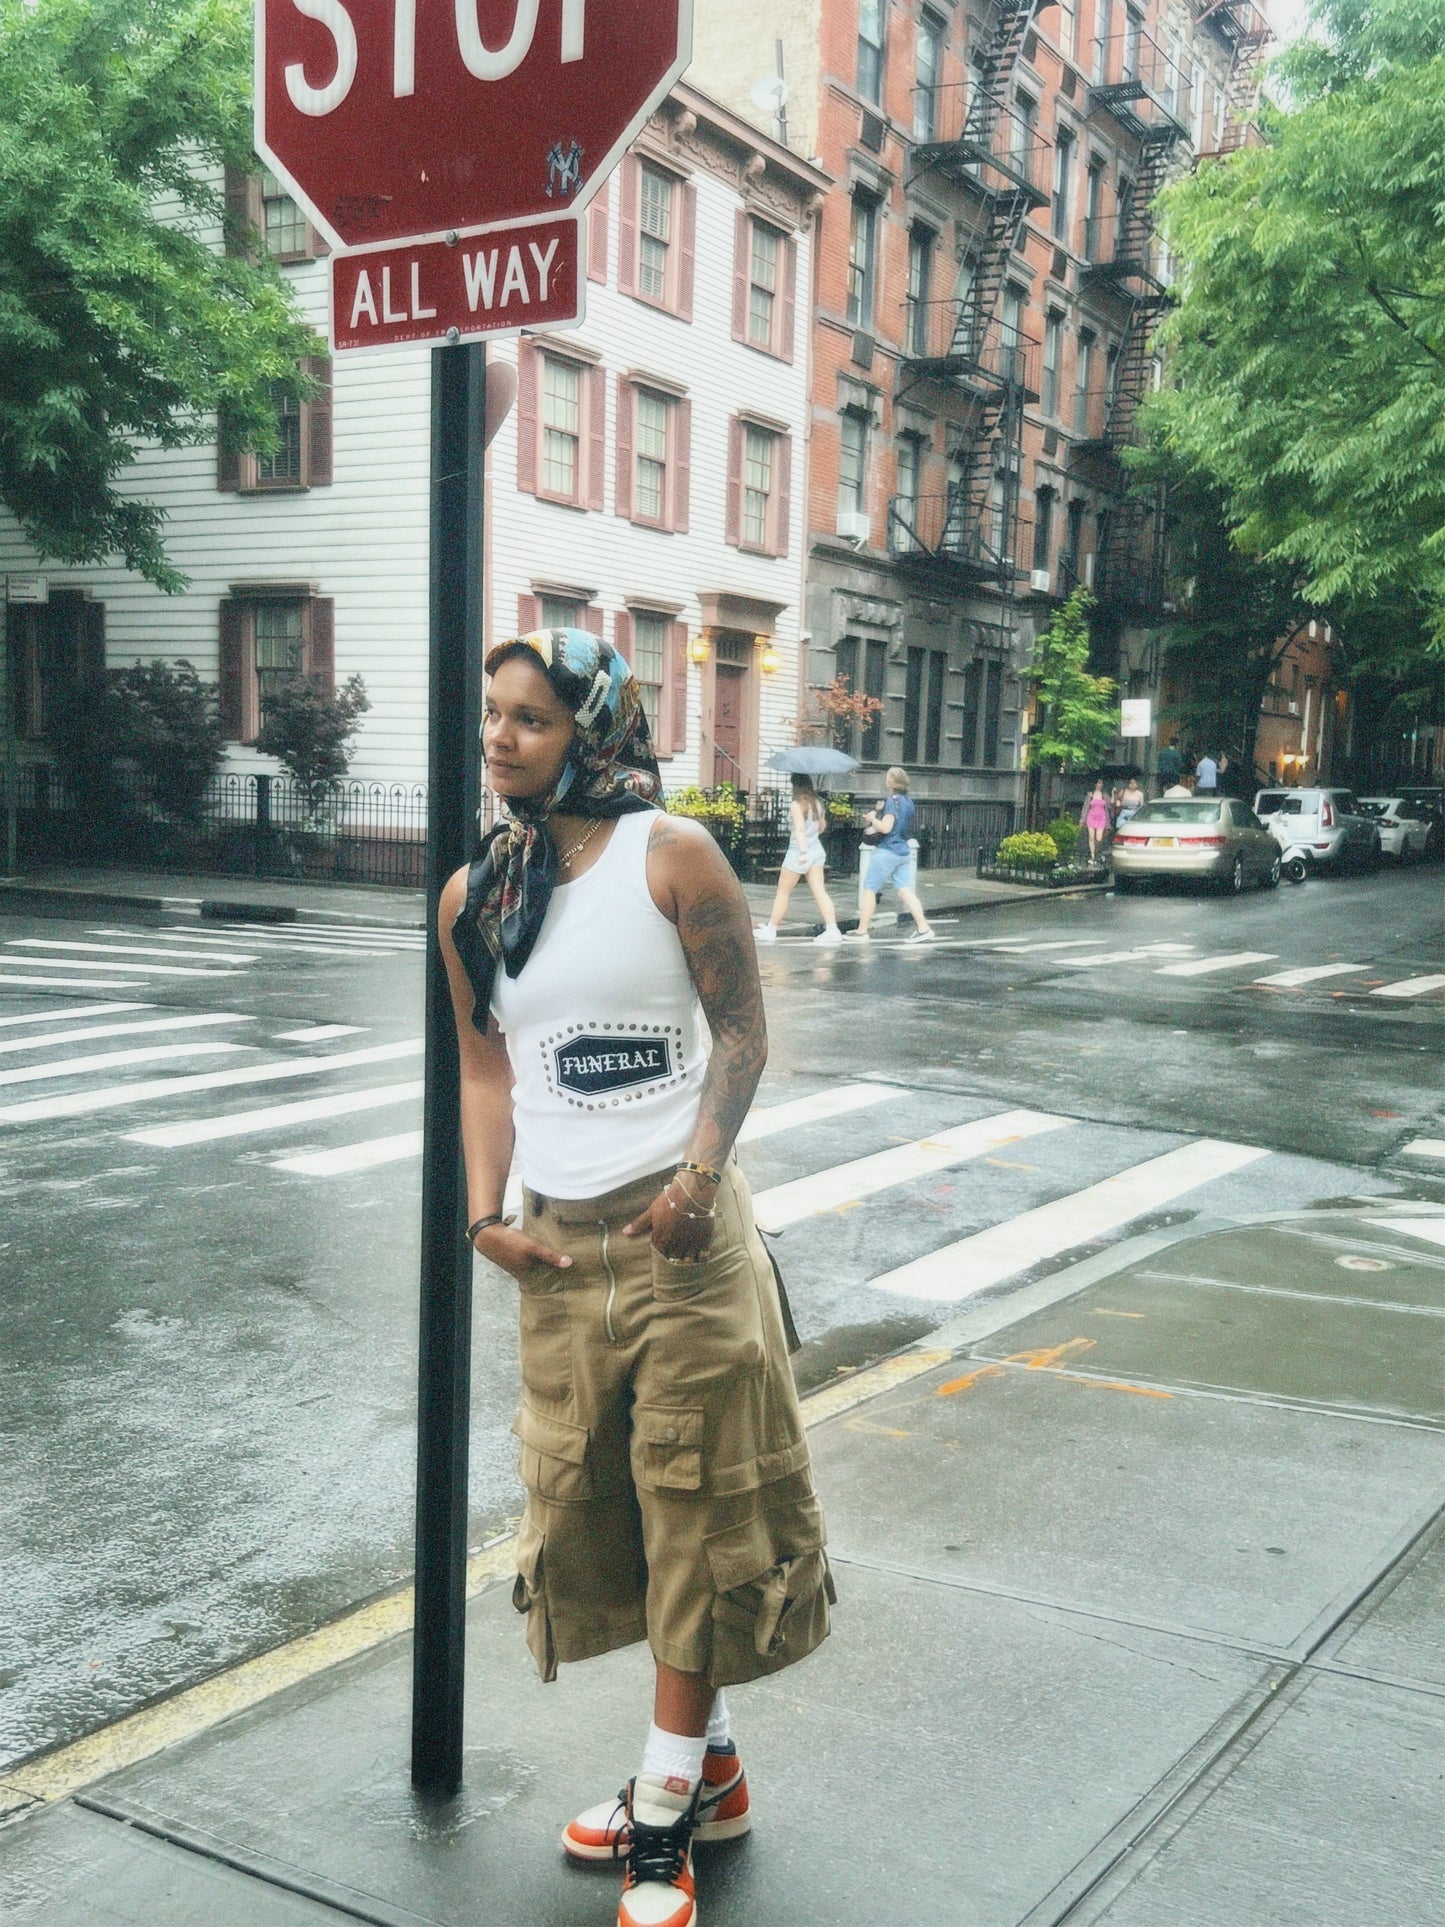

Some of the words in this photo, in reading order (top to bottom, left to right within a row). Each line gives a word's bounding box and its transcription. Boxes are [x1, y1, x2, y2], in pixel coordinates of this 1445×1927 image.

[350, 262, 437, 329] ALL
[462, 238, 560, 312] WAY
[435, 320, 513, 337] TRSPORTATION
[562, 1049, 661, 1075] FUNERAL
